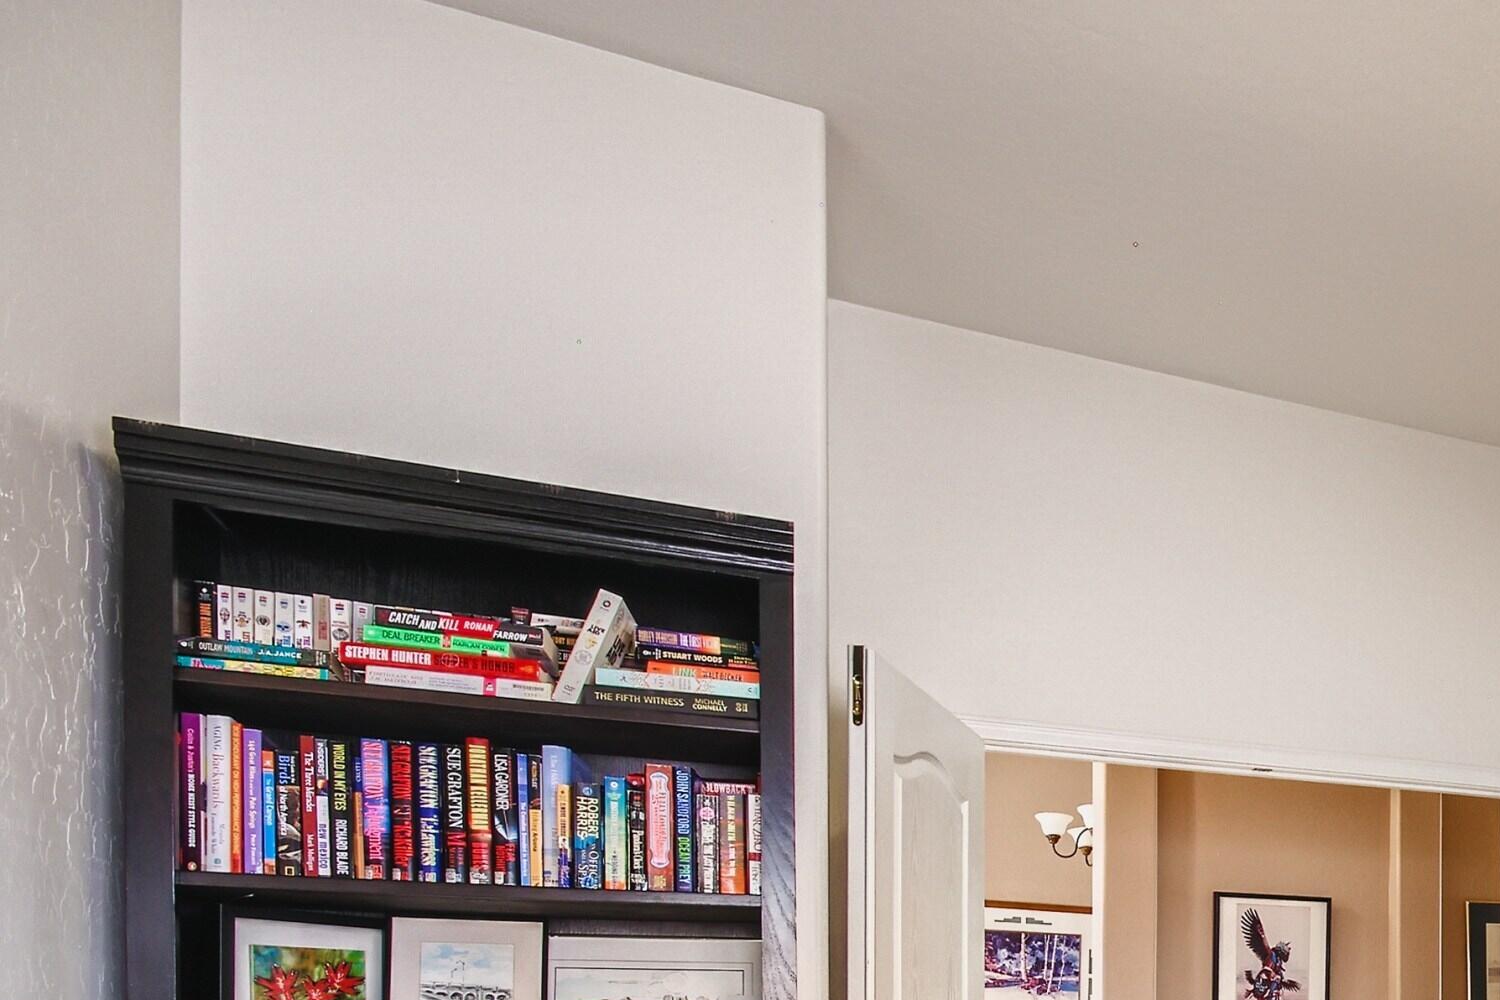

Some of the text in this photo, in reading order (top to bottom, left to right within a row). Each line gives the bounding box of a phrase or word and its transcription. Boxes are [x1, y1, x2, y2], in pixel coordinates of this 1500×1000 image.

[382, 630, 440, 644] DEAL BREAKER
[388, 612, 528, 642] CATCH AND KILL RONAN FARROW
[344, 646, 432, 664] STEPHEN HUNTER
[662, 651, 692, 660] STUART
[694, 654, 723, 663] WOODS
[594, 692, 685, 706] THE FIFTH WITNESS
[692, 703, 728, 712] CONNELLY
[305, 752, 313, 766] The
[333, 744, 345, 769] WORLD
[279, 755, 289, 784] Birds
[305, 767, 314, 786] Three
[211, 753, 225, 809] Backwards
[334, 780, 346, 792] MY
[419, 766, 439, 809] GRAFTON
[447, 748, 463, 828] SUE GRAFTON
[469, 745, 489, 831] JONATHAN KELLERMAN
[495, 754, 509, 810] LISA GARDNER
[280, 794, 288, 811] North
[334, 793, 346, 811] EYES
[265, 805, 273, 825] Canyon
[577, 796, 588, 840] HARRIS
[588, 798, 599, 838] ROBERT
[676, 770, 690, 883] JOHN SANDFORD OCEAN PREY
[335, 819, 349, 875] RICHARD BLADE
[633, 855, 643, 869] Clock
